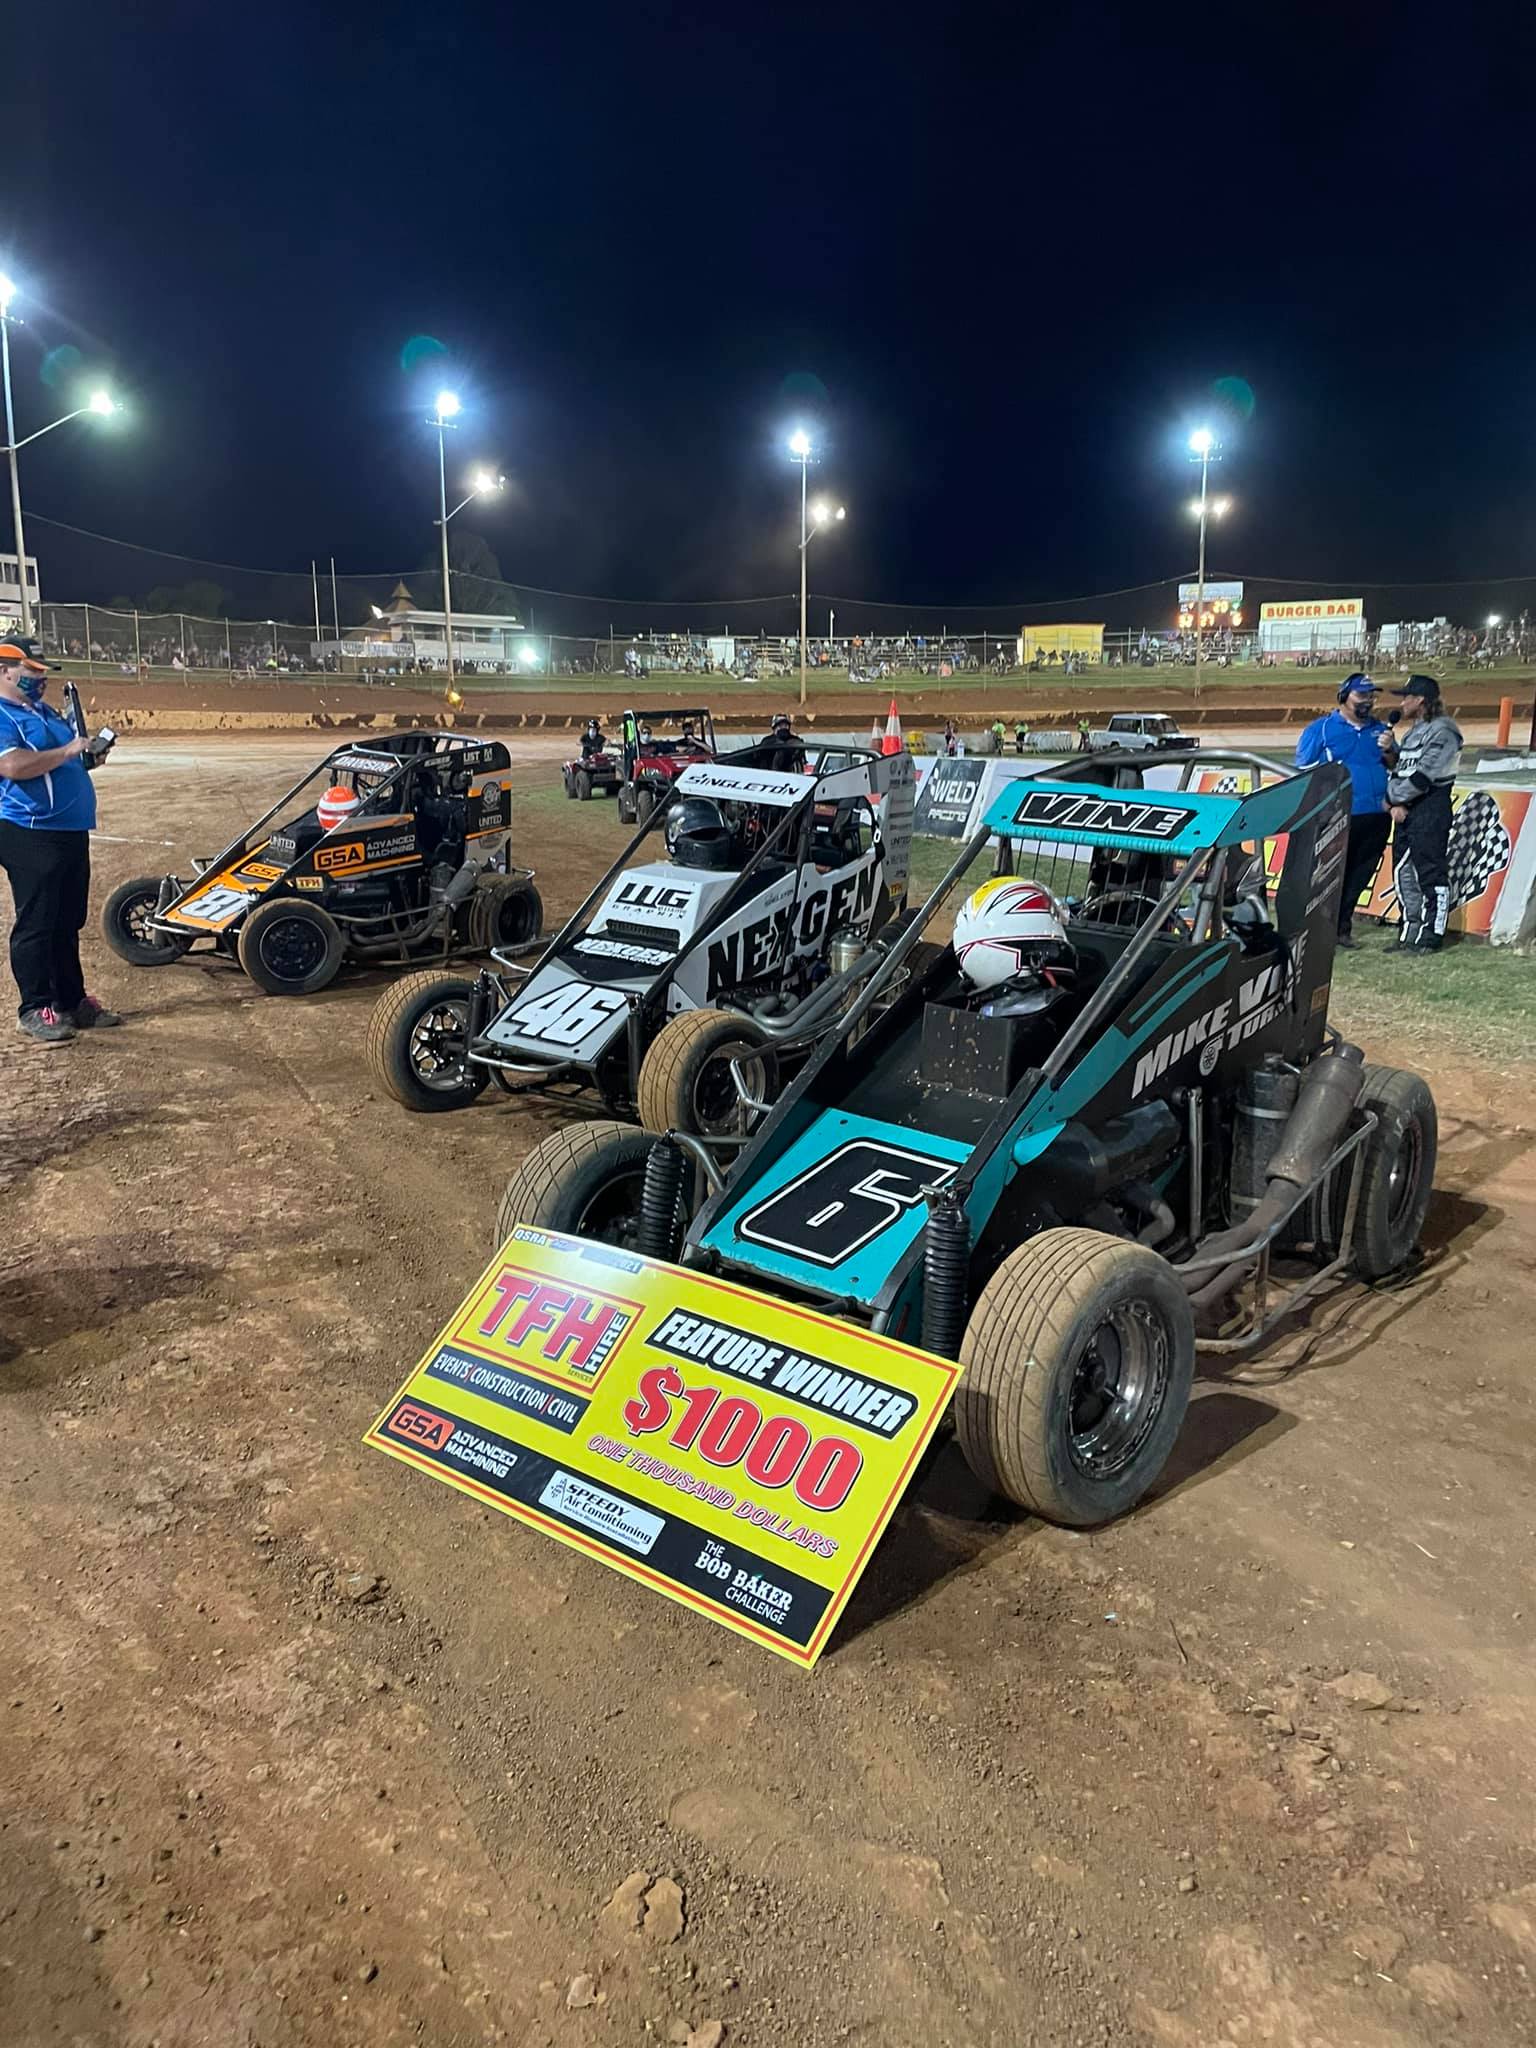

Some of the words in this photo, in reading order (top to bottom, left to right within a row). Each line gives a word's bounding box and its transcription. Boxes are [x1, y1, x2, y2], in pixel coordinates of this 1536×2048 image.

[1267, 606, 1321, 617] BURGER
[1328, 604, 1355, 615] BAR
[688, 773, 800, 795] SINGLETON
[934, 780, 976, 804] WELD
[1018, 793, 1188, 836] VINE
[318, 847, 362, 868] GSA
[367, 835, 415, 850] ADVANCED
[367, 844, 415, 859] MACHINING
[299, 879, 320, 888] TFH
[573, 938, 677, 963] NEXGEN
[511, 980, 629, 1044] 46
[1132, 998, 1232, 1099] MIKE
[740, 1140, 959, 1265] 6
[514, 1229, 547, 1245] QSRA
[479, 1275, 620, 1369] TFH
[583, 1314, 630, 1373] HIRE
[433, 1353, 471, 1379] EVENTS
[470, 1371, 549, 1407] CONSTRUCTION
[547, 1399, 581, 1423] CIVIL
[653, 1314, 784, 1380] FEATURE
[771, 1350, 914, 1433] WINNER
[393, 1408, 446, 1444] GSA
[622, 1365, 863, 1512] $1000
[444, 1441, 510, 1479] MACHINING
[451, 1430, 518, 1465] ADVANCED
[566, 1484, 631, 1516] SPEEDY
[587, 1435, 631, 1463] ONE
[628, 1449, 736, 1511] THOUSAND
[732, 1499, 838, 1558] DOLLARS
[564, 1495, 582, 1507] Air
[581, 1501, 653, 1545] Conditioning
[704, 1539, 726, 1558] THE
[694, 1551, 733, 1580] BOB
[731, 1568, 793, 1612] BAKER
[725, 1586, 787, 1625] CHALLENGE
